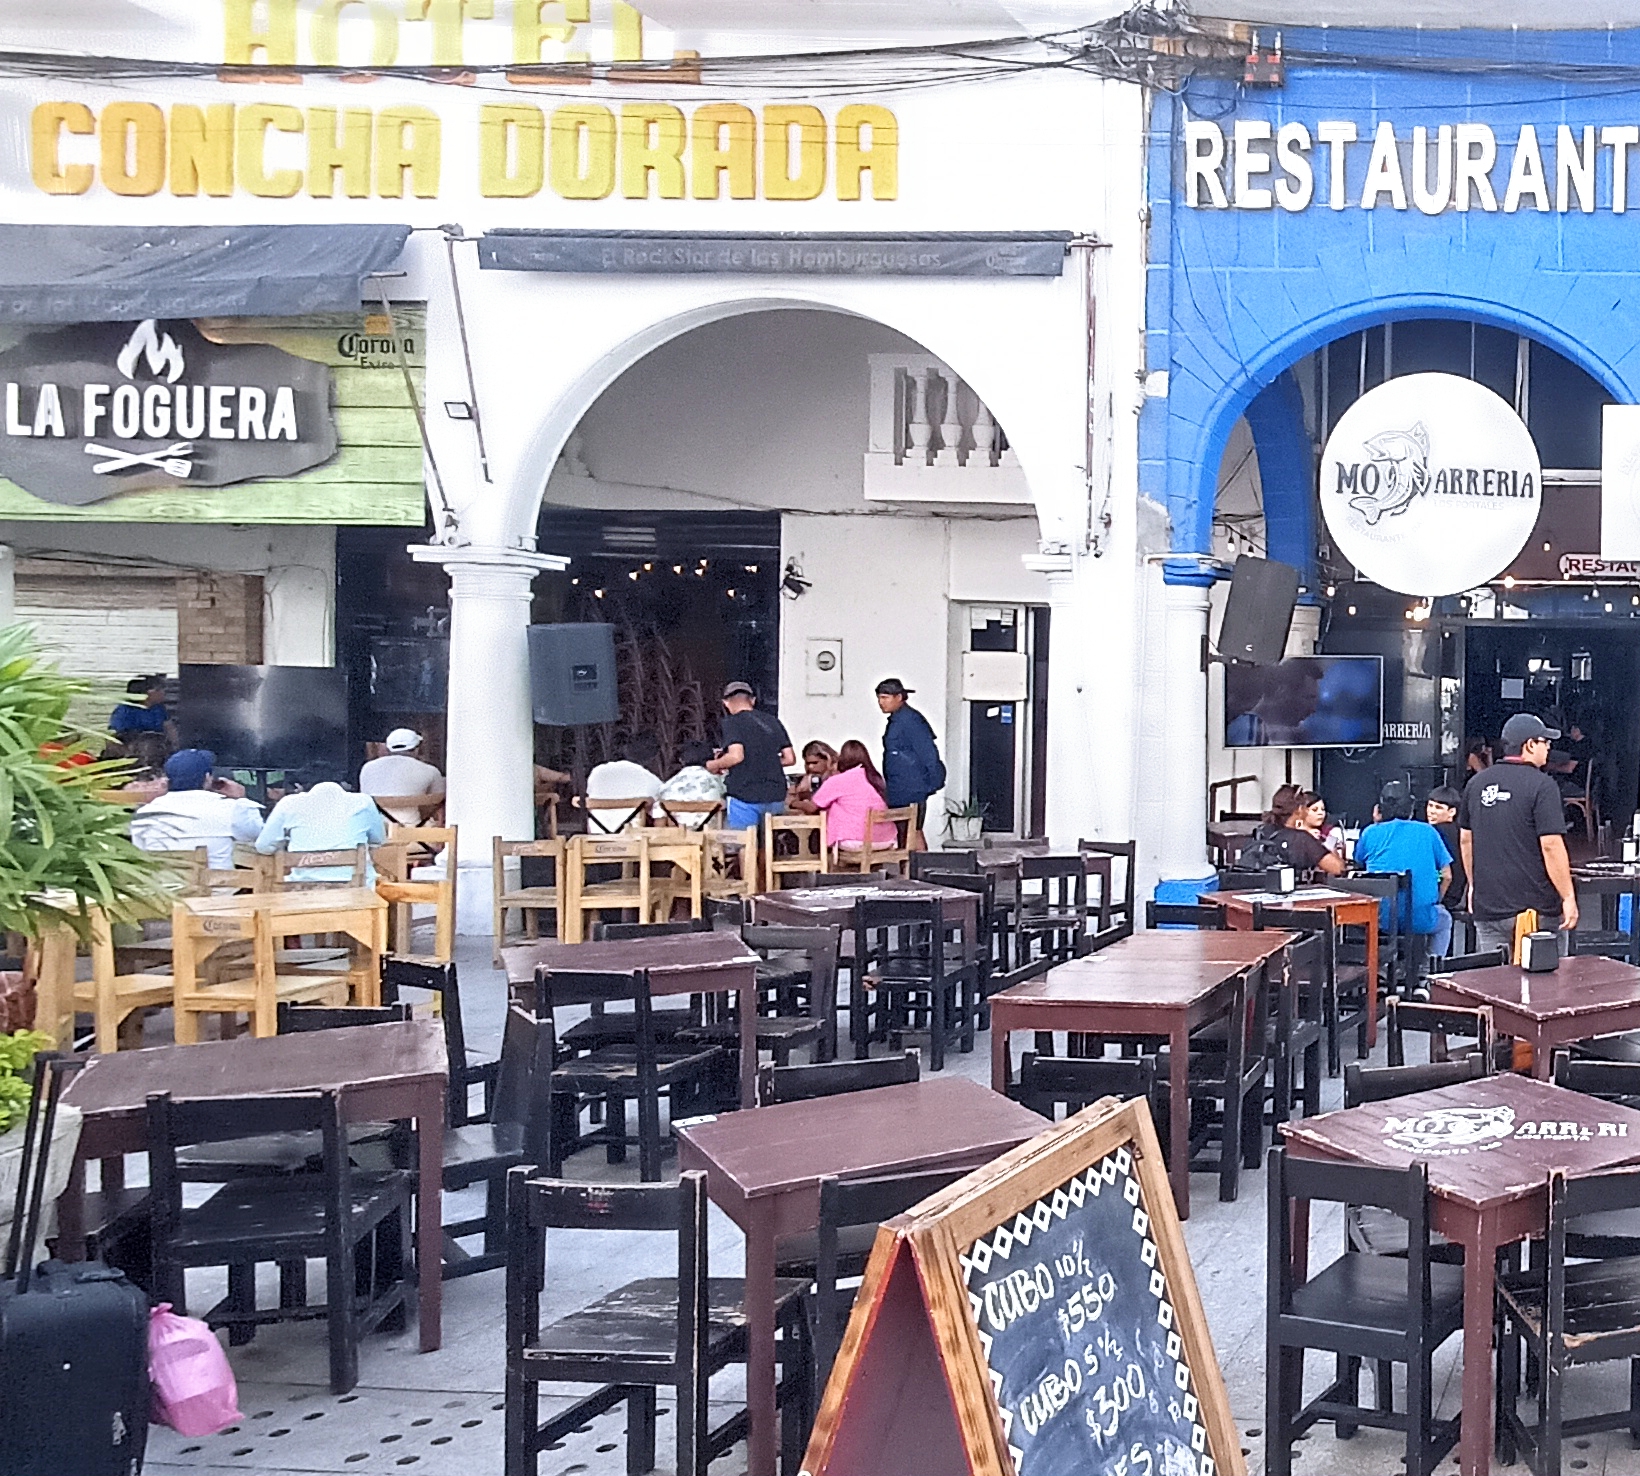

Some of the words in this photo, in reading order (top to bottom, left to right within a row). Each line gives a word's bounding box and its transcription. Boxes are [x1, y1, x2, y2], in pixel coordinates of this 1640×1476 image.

[30, 101, 442, 199] CONCHA
[479, 102, 899, 202] DORADA
[6, 382, 66, 438] LA
[83, 384, 298, 441] FOGUERA
[982, 1262, 1054, 1331] CUBO
[1057, 1272, 1116, 1340] $550
[1019, 1358, 1082, 1437] CUBO
[1085, 1363, 1146, 1447] $300
